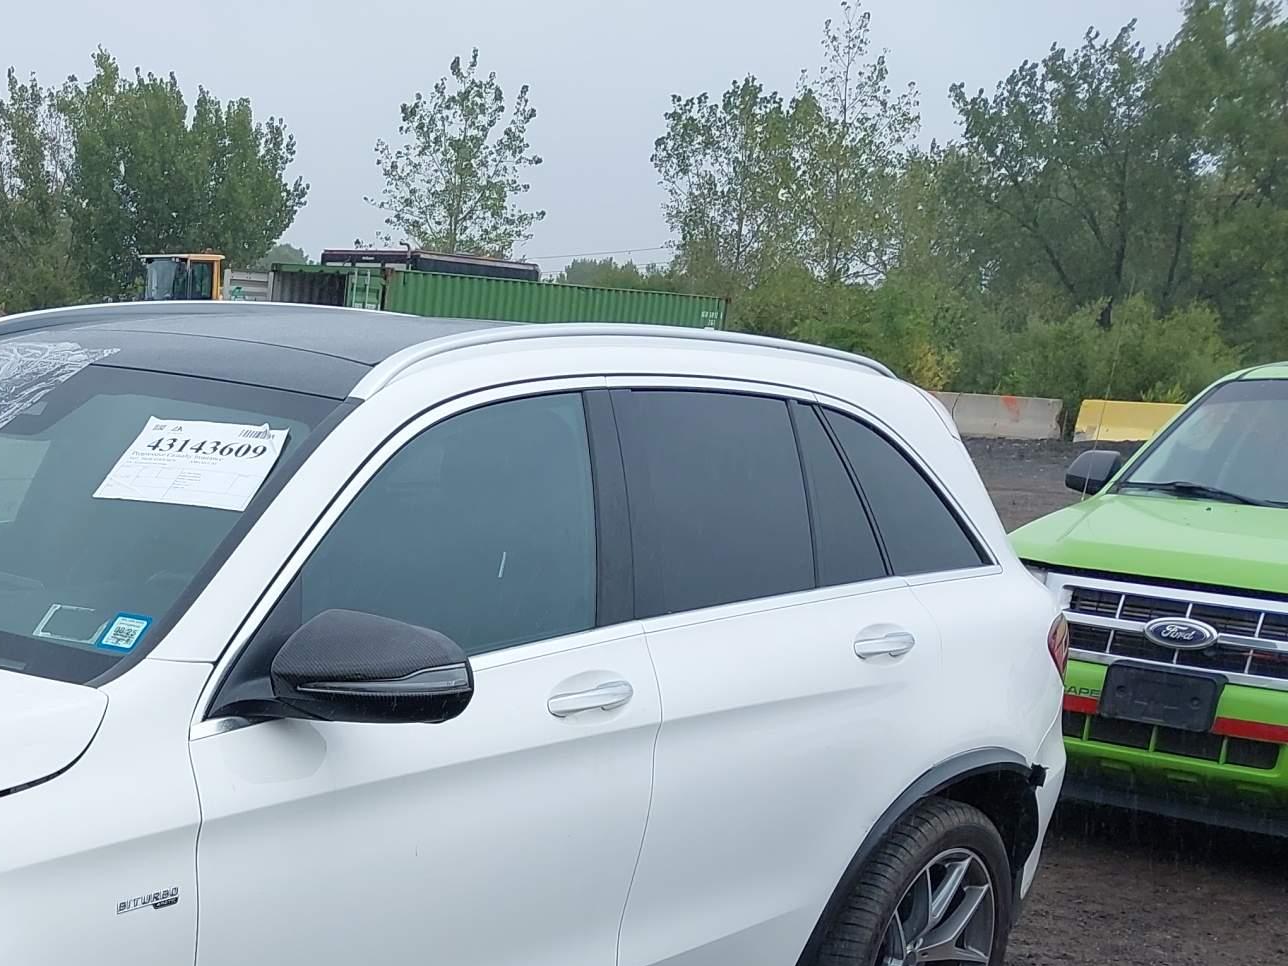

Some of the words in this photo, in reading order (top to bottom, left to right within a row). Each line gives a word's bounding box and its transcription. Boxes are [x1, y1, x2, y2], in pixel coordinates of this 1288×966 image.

[147, 437, 267, 459] 43143609
[1161, 624, 1197, 640] Ford
[118, 887, 179, 911] BITURBO
